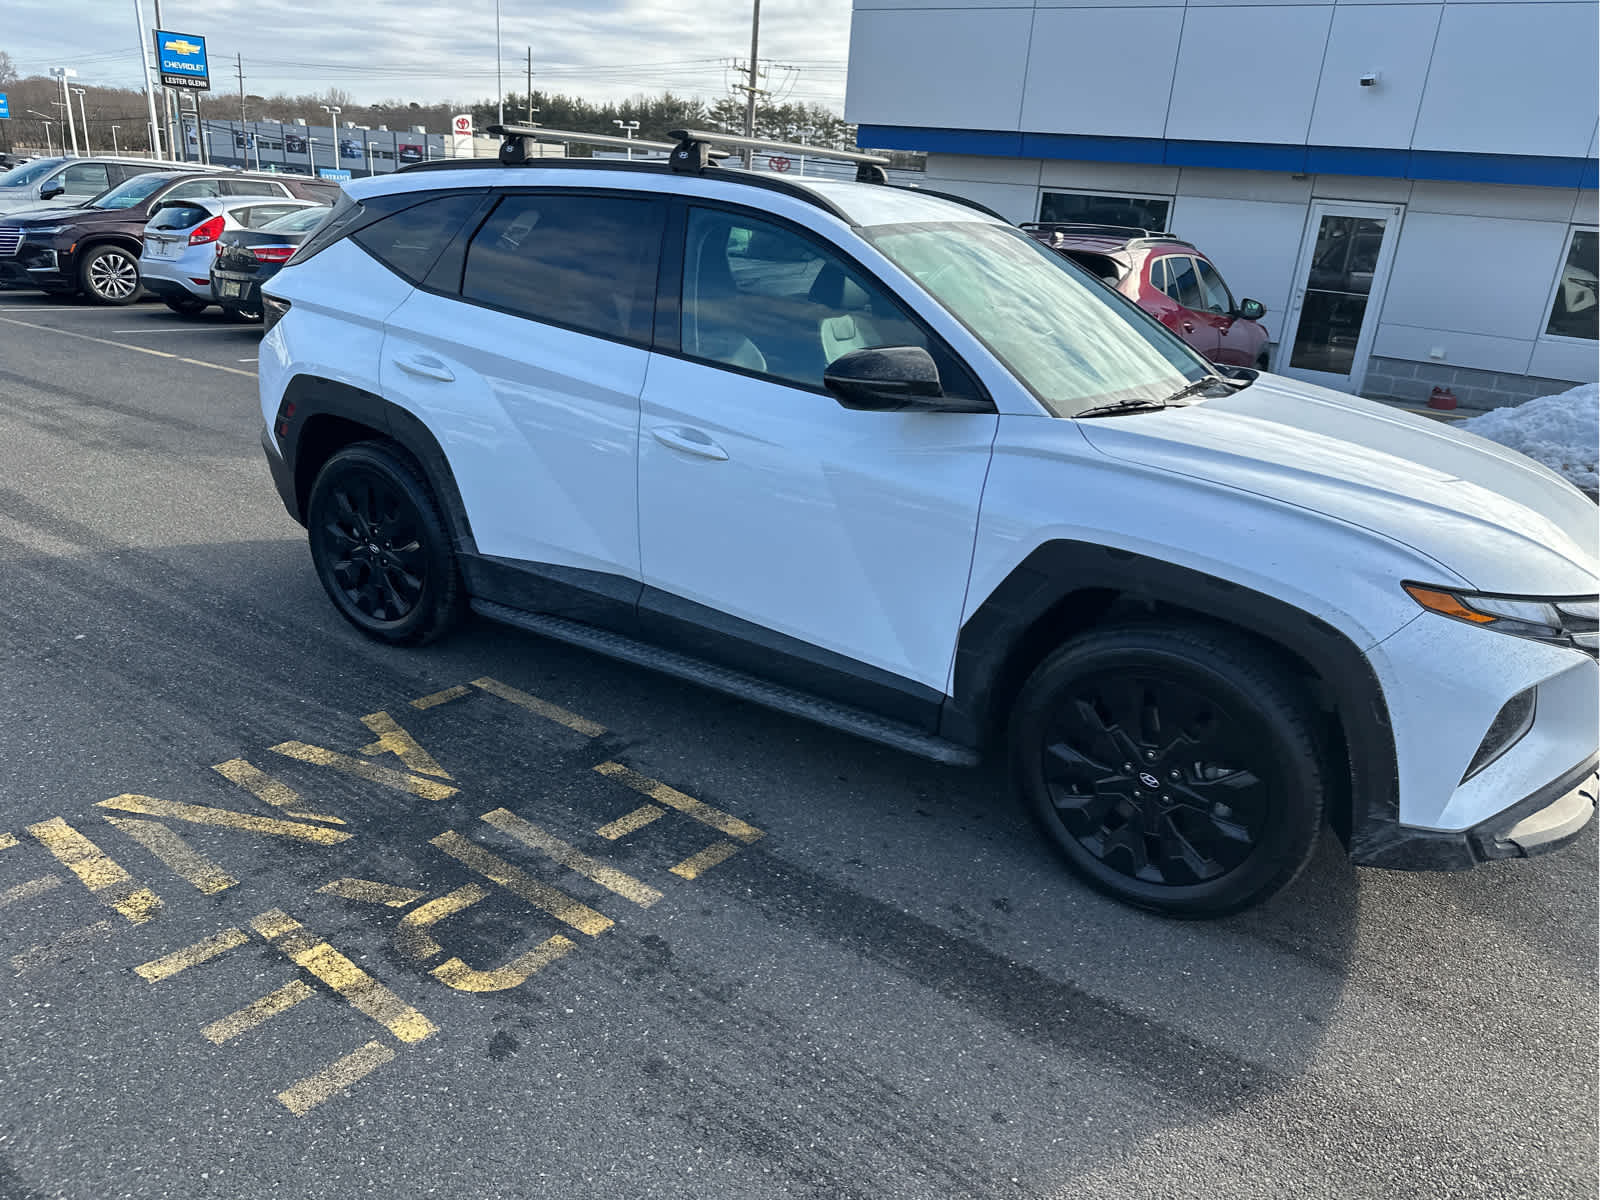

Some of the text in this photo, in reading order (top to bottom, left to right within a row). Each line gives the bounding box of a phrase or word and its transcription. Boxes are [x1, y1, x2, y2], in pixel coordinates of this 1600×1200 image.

[164, 60, 204, 72] CHEVROLET
[165, 77, 207, 87] LESTER GLENN
[0, 676, 607, 973] LANE
[134, 762, 767, 1117] FIRE
